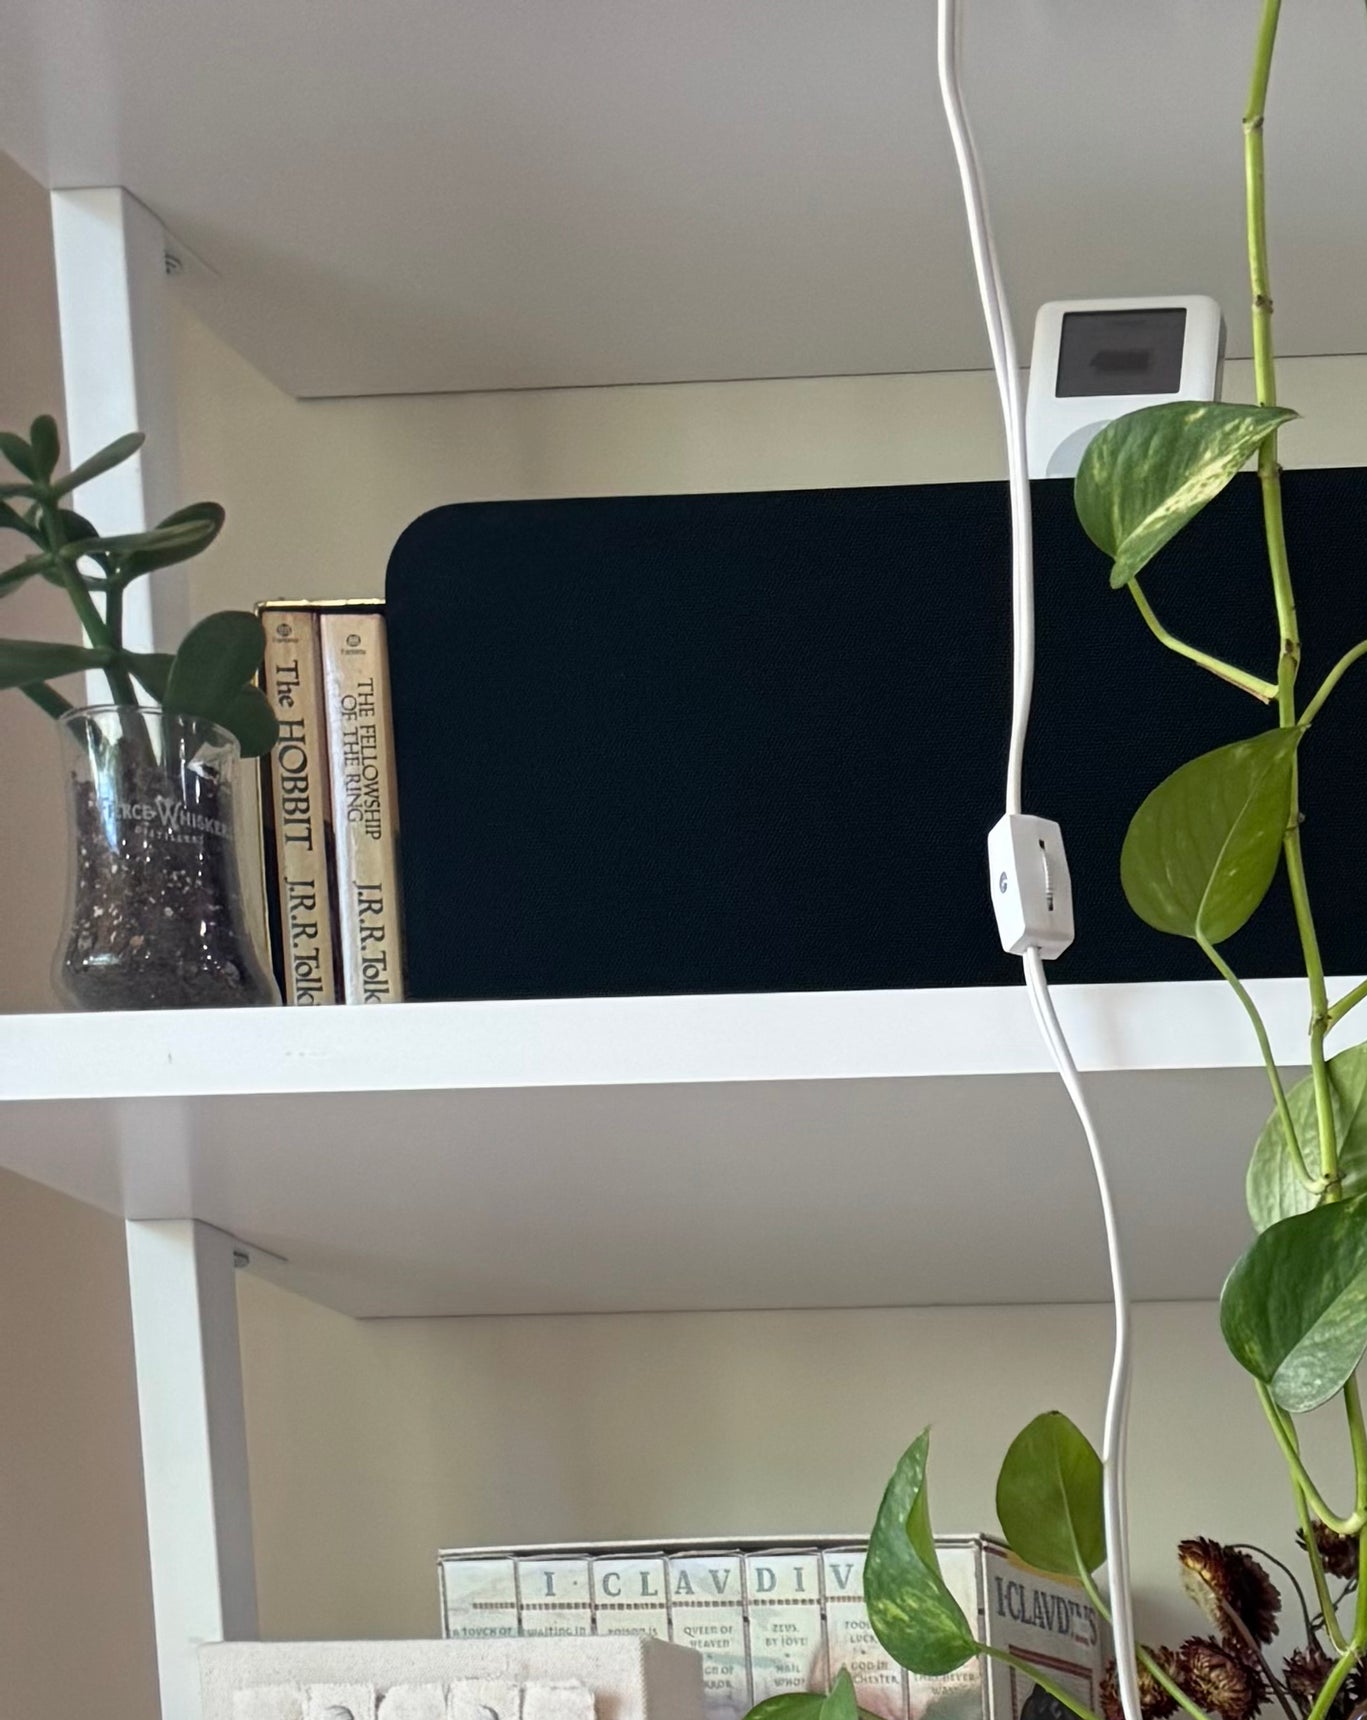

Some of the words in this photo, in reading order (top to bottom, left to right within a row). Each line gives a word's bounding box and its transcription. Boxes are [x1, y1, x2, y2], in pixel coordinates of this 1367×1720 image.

[275, 659, 300, 708] The
[357, 677, 375, 717] THE
[341, 694, 358, 721] OF
[343, 728, 360, 768] THE
[278, 718, 313, 851] HOBBIT
[344, 772, 364, 823] RING
[360, 724, 382, 841] FELLOWSHIP
[601, 1563, 855, 1598] CLAVDIV
